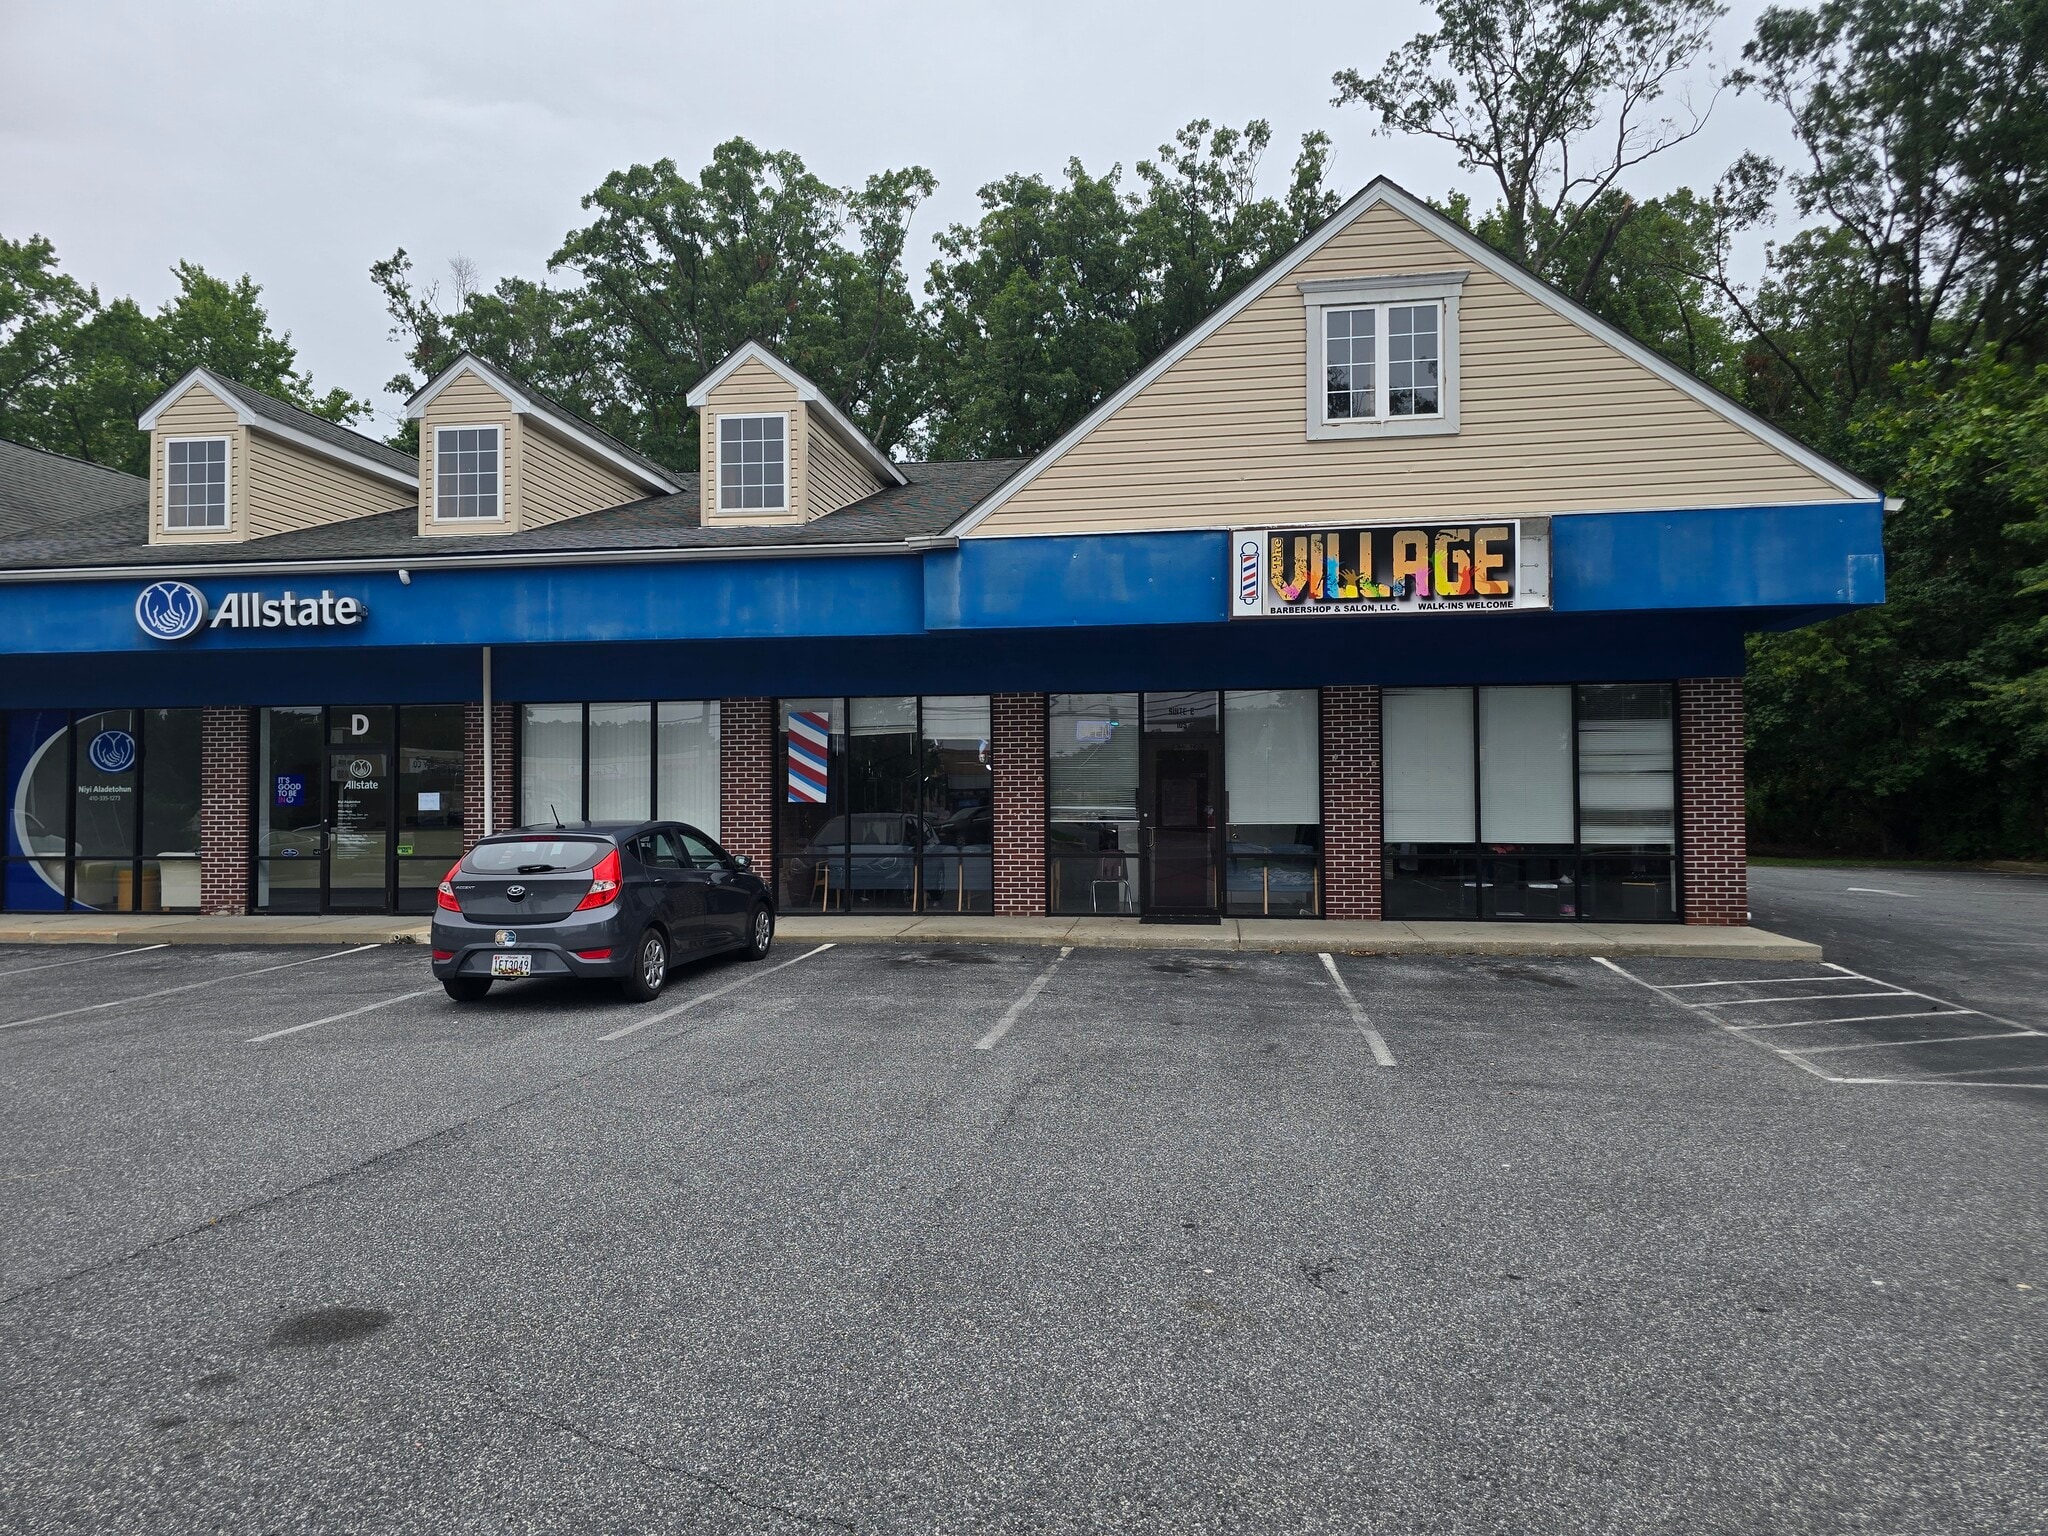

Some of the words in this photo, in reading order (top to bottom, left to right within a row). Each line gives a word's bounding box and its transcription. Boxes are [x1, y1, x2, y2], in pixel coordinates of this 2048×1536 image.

[1270, 527, 1509, 601] VILLAGE
[1272, 538, 1283, 569] The
[209, 590, 358, 628] Allstate
[1270, 606, 1332, 614] BARBERSHOP
[1343, 605, 1378, 613] SALON,
[1379, 604, 1400, 612] LLC.
[1418, 602, 1464, 610] WALK-INS
[1466, 601, 1514, 609] WELCOME
[352, 714, 370, 735] D
[344, 781, 378, 790] Allstate
